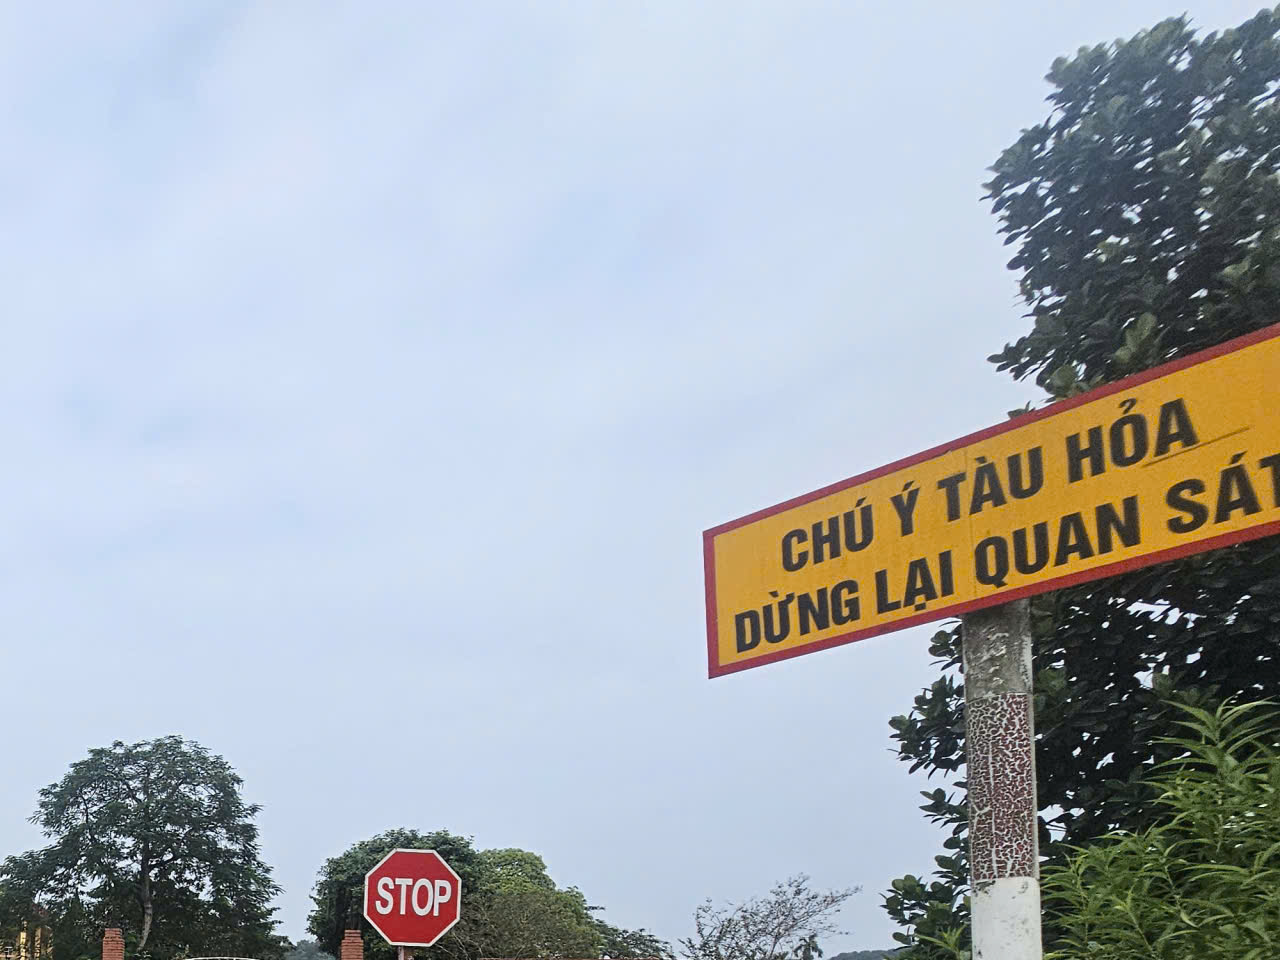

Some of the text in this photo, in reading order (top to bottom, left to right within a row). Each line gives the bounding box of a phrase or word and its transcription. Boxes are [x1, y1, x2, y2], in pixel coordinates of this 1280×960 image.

[734, 451, 1280, 654] DỪNG LẠI QUAN SÁT
[781, 398, 1198, 572] CHÚ Ý TÀU HỎA
[375, 877, 452, 917] STOP
